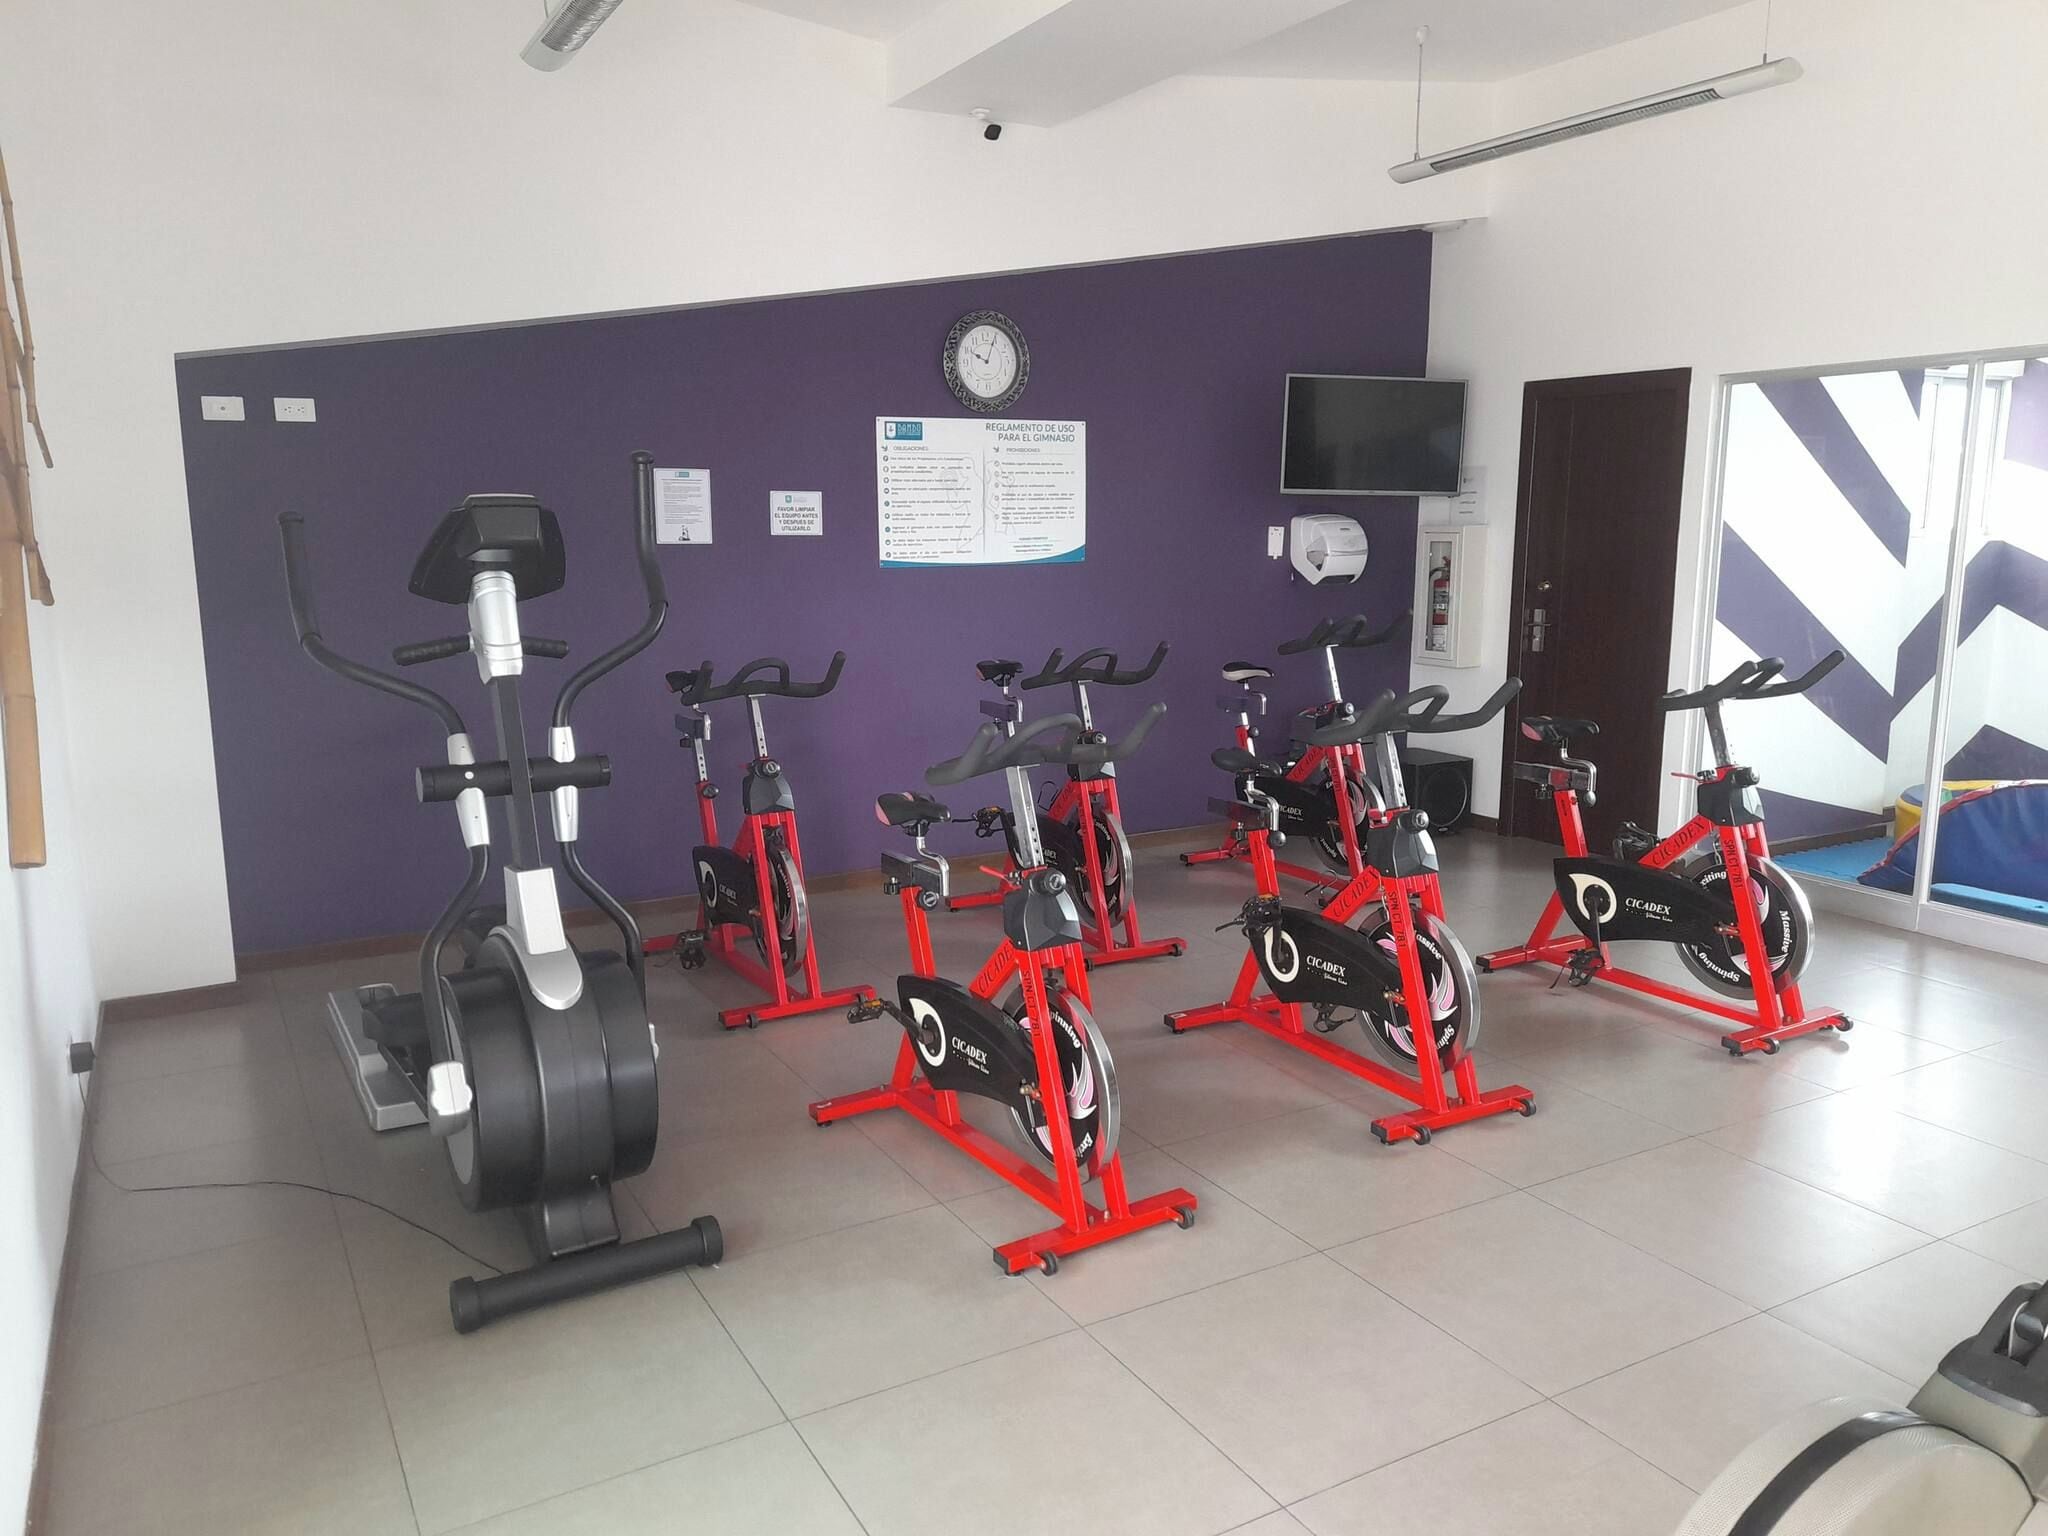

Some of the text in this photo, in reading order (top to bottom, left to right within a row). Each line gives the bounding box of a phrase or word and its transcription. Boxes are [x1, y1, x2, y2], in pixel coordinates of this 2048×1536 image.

[985, 422, 1076, 433] REGLAMENTO DE USO
[998, 433, 1076, 443] PARA EL GIMNASIO
[1699, 870, 1728, 887] citing
[1625, 897, 1671, 915] CICADEX
[1779, 909, 1793, 953] Massive
[1414, 931, 1443, 960] assive
[977, 943, 1014, 993] CICADE
[1306, 954, 1346, 977] CICADEX
[1698, 952, 1741, 982] Spinning
[1050, 1010, 1081, 1049] pinning
[1436, 1023, 1455, 1050] Spin
[951, 1036, 987, 1065] CICADEX
